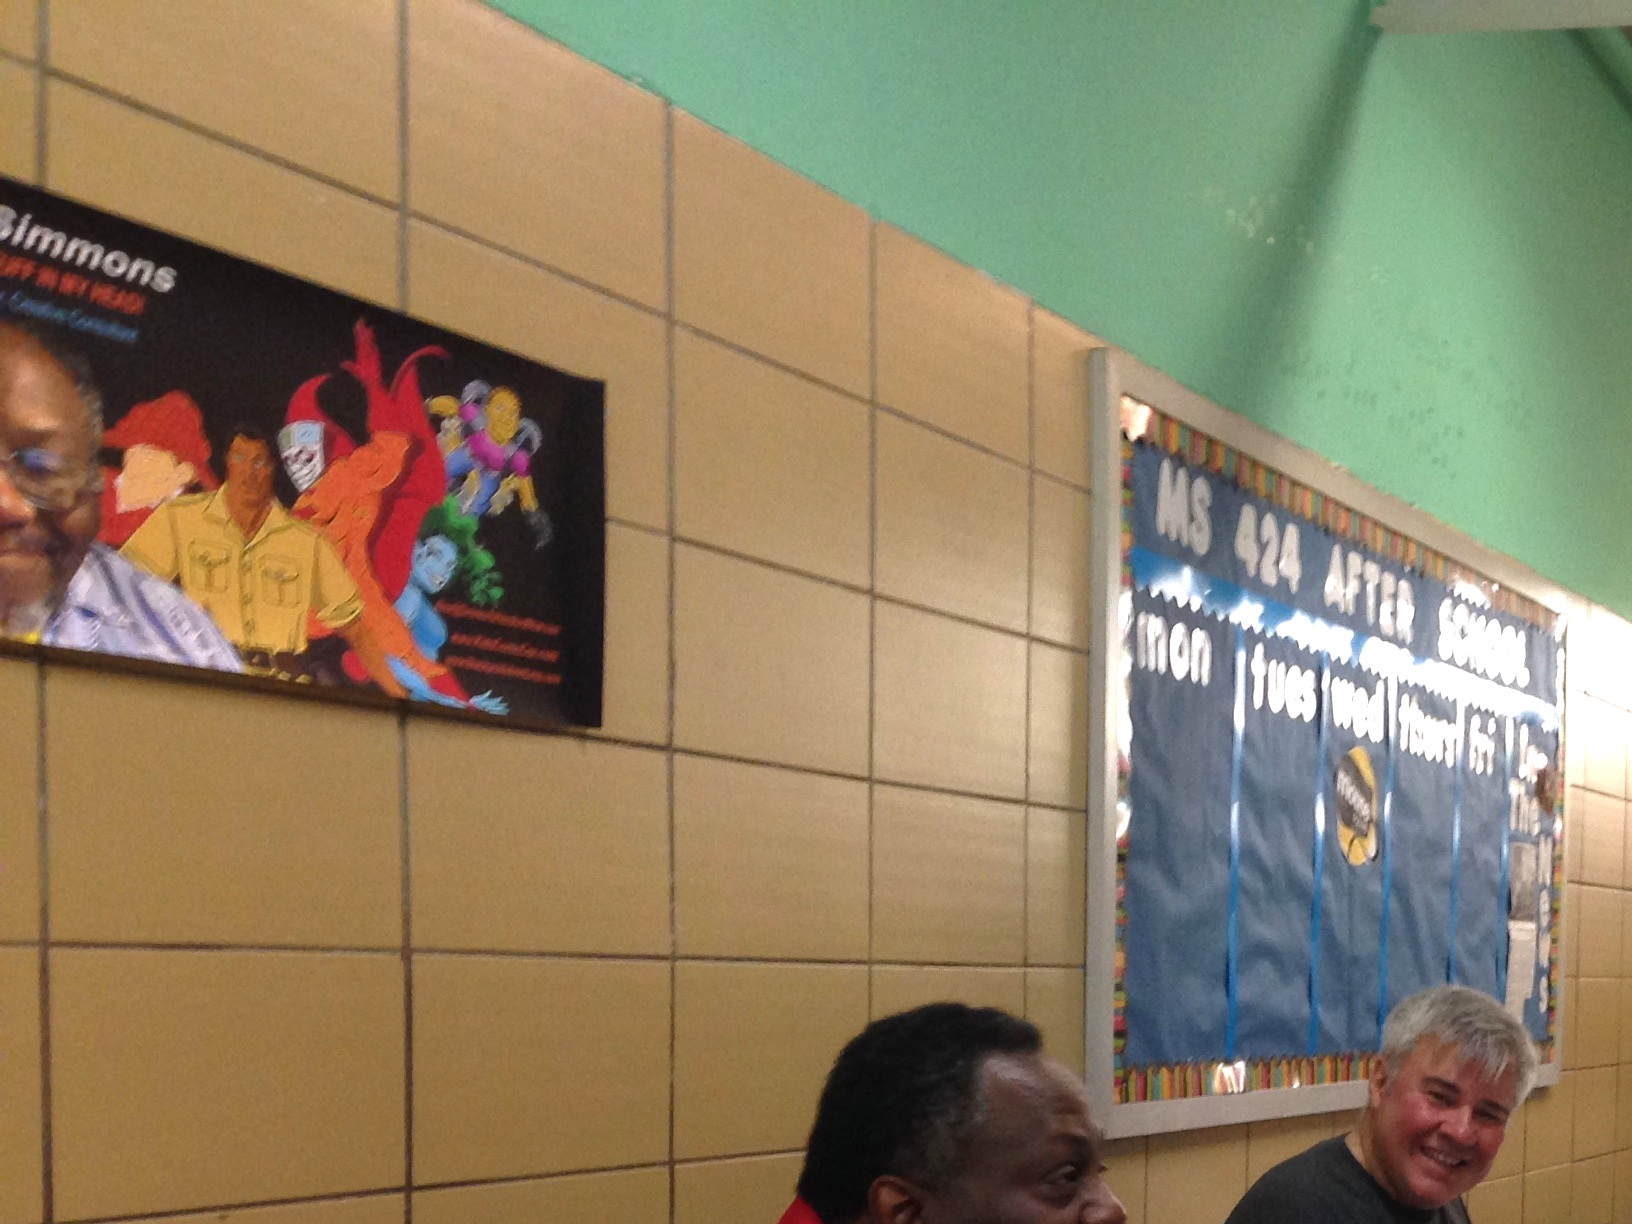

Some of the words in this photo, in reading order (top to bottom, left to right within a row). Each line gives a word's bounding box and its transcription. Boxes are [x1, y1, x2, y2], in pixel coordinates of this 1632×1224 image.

[1156, 457, 1213, 556] MS
[1234, 503, 1302, 594] 424
[1323, 543, 1416, 645] AFTER
[1437, 597, 1531, 688] SCHOOL
[1136, 611, 1213, 686] mon
[1250, 642, 1317, 722] tues
[1331, 676, 1385, 743] wed
